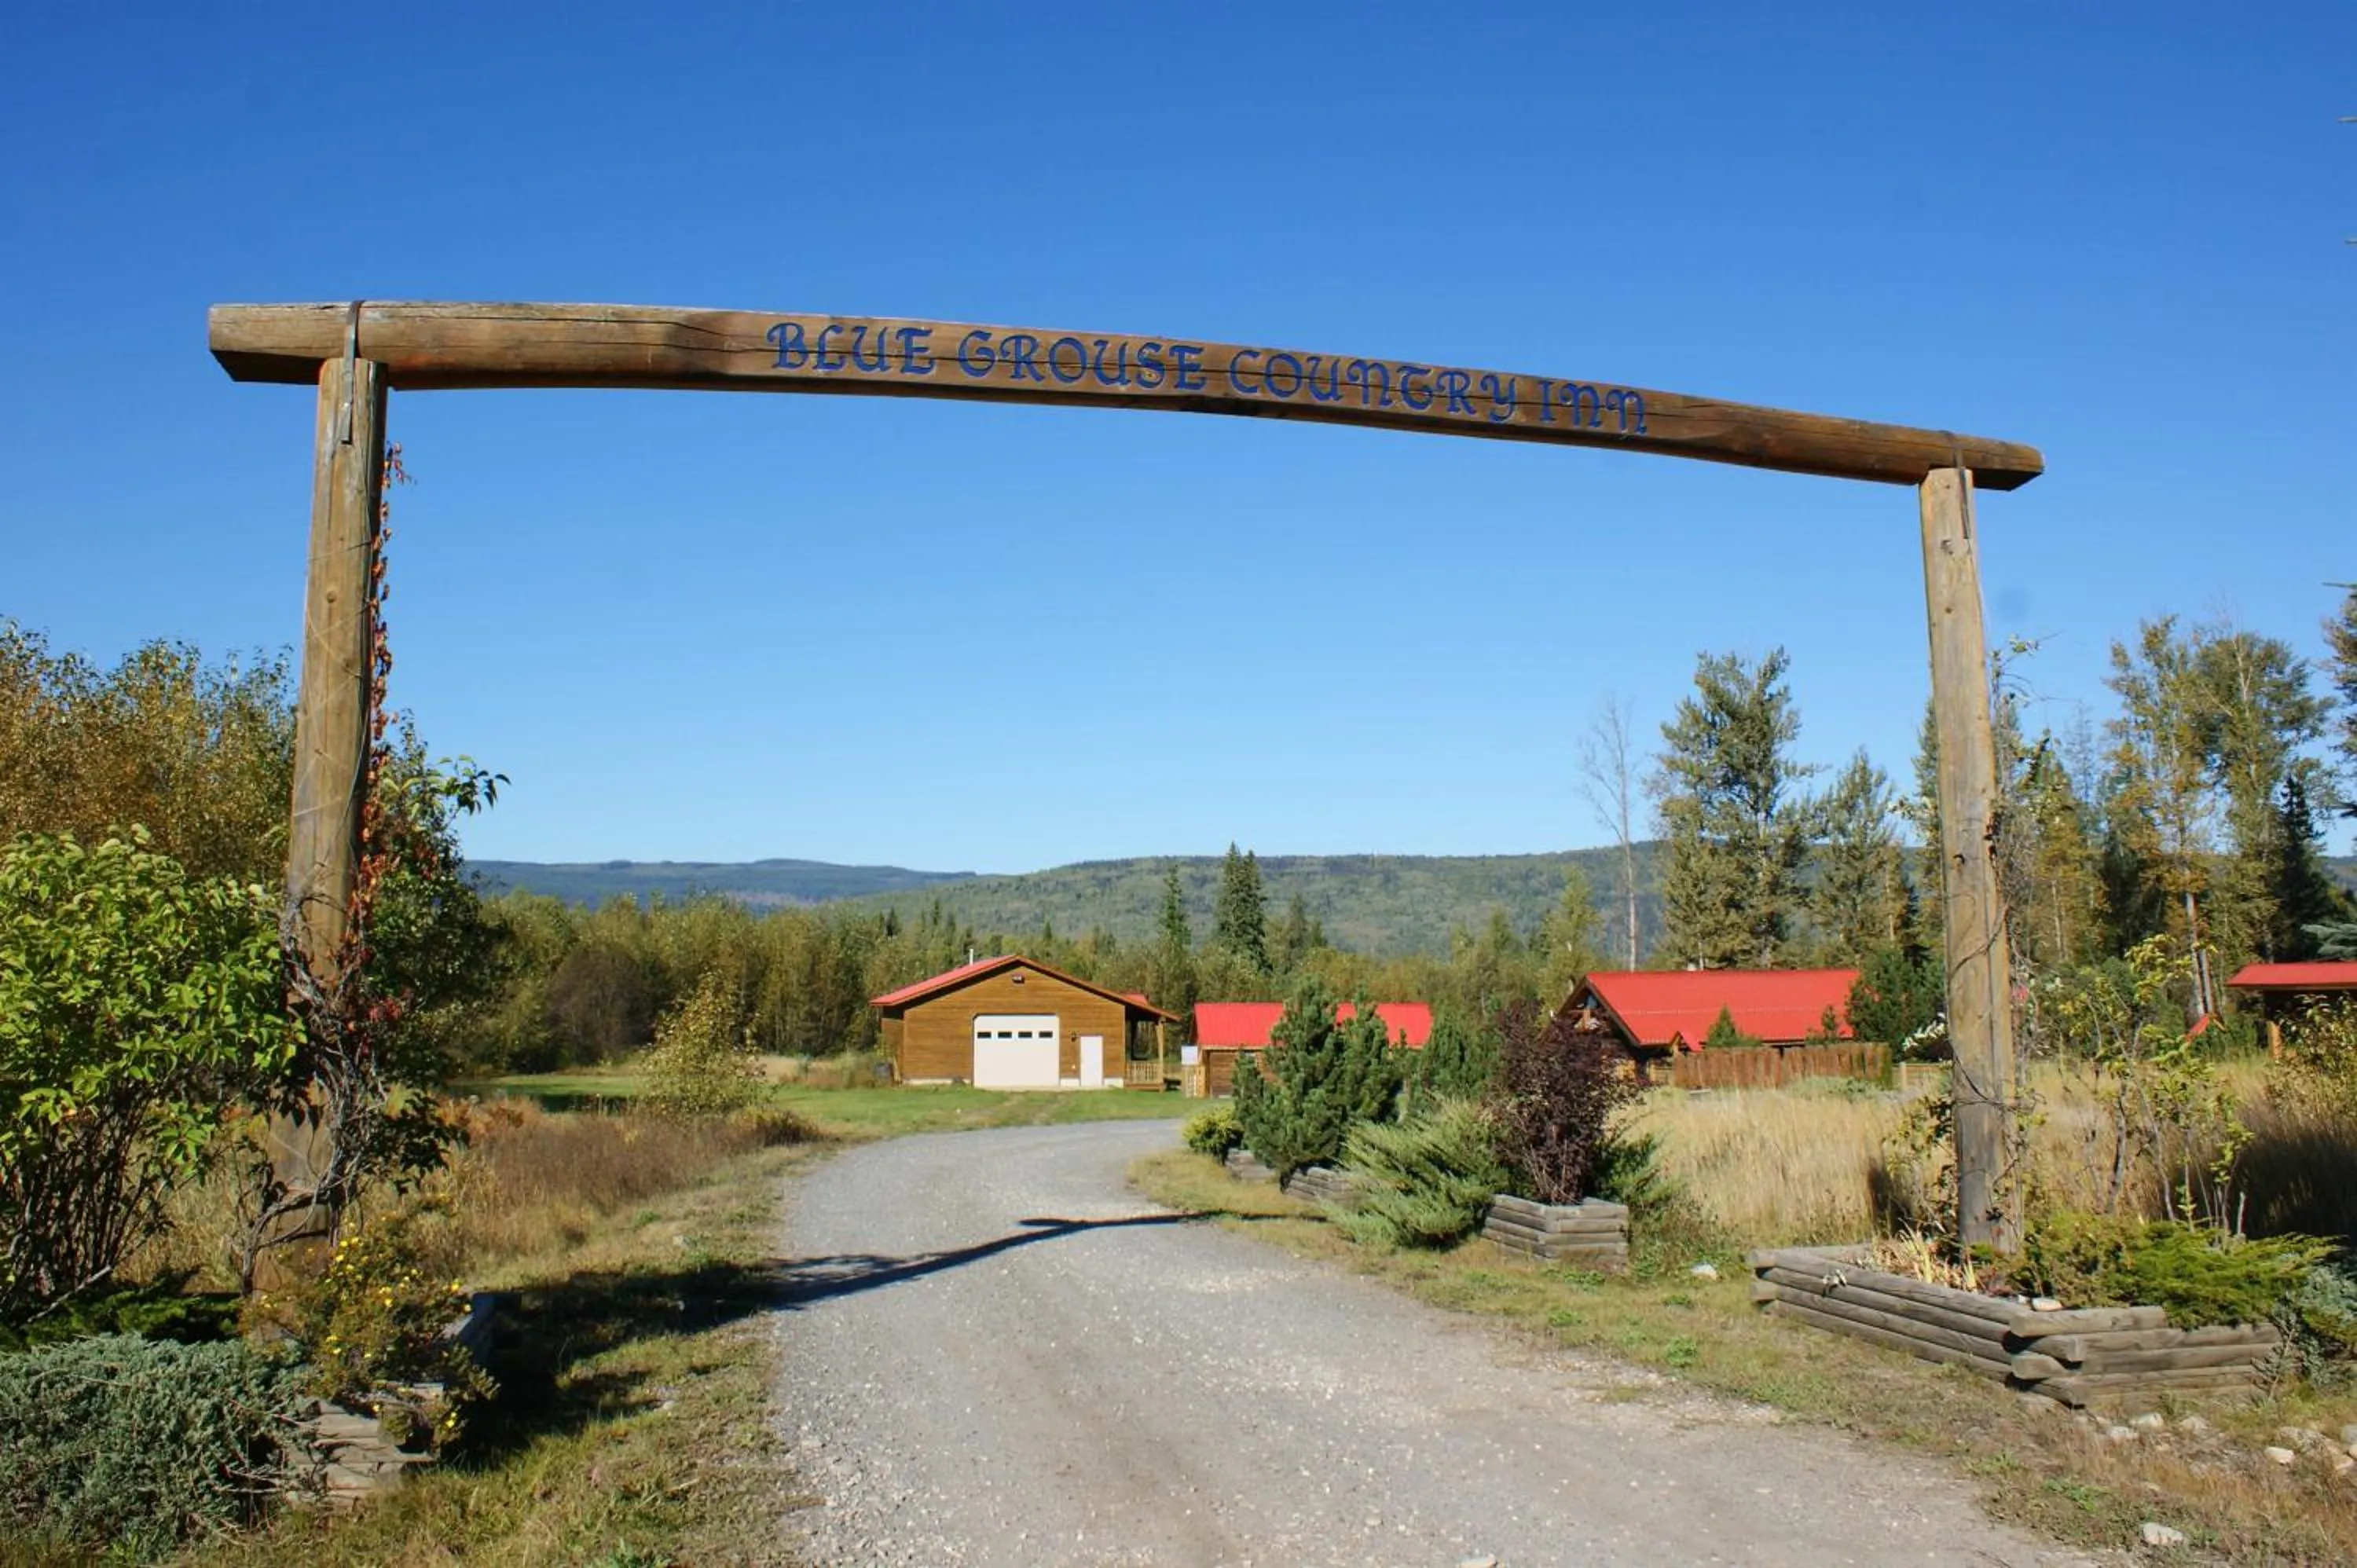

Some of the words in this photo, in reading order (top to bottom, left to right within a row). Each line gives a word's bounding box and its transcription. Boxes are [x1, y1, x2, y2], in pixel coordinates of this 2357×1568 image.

[767, 322, 936, 375] BLUE
[958, 330, 1207, 390] GROUSE
[1230, 350, 1518, 423] COUNTRY
